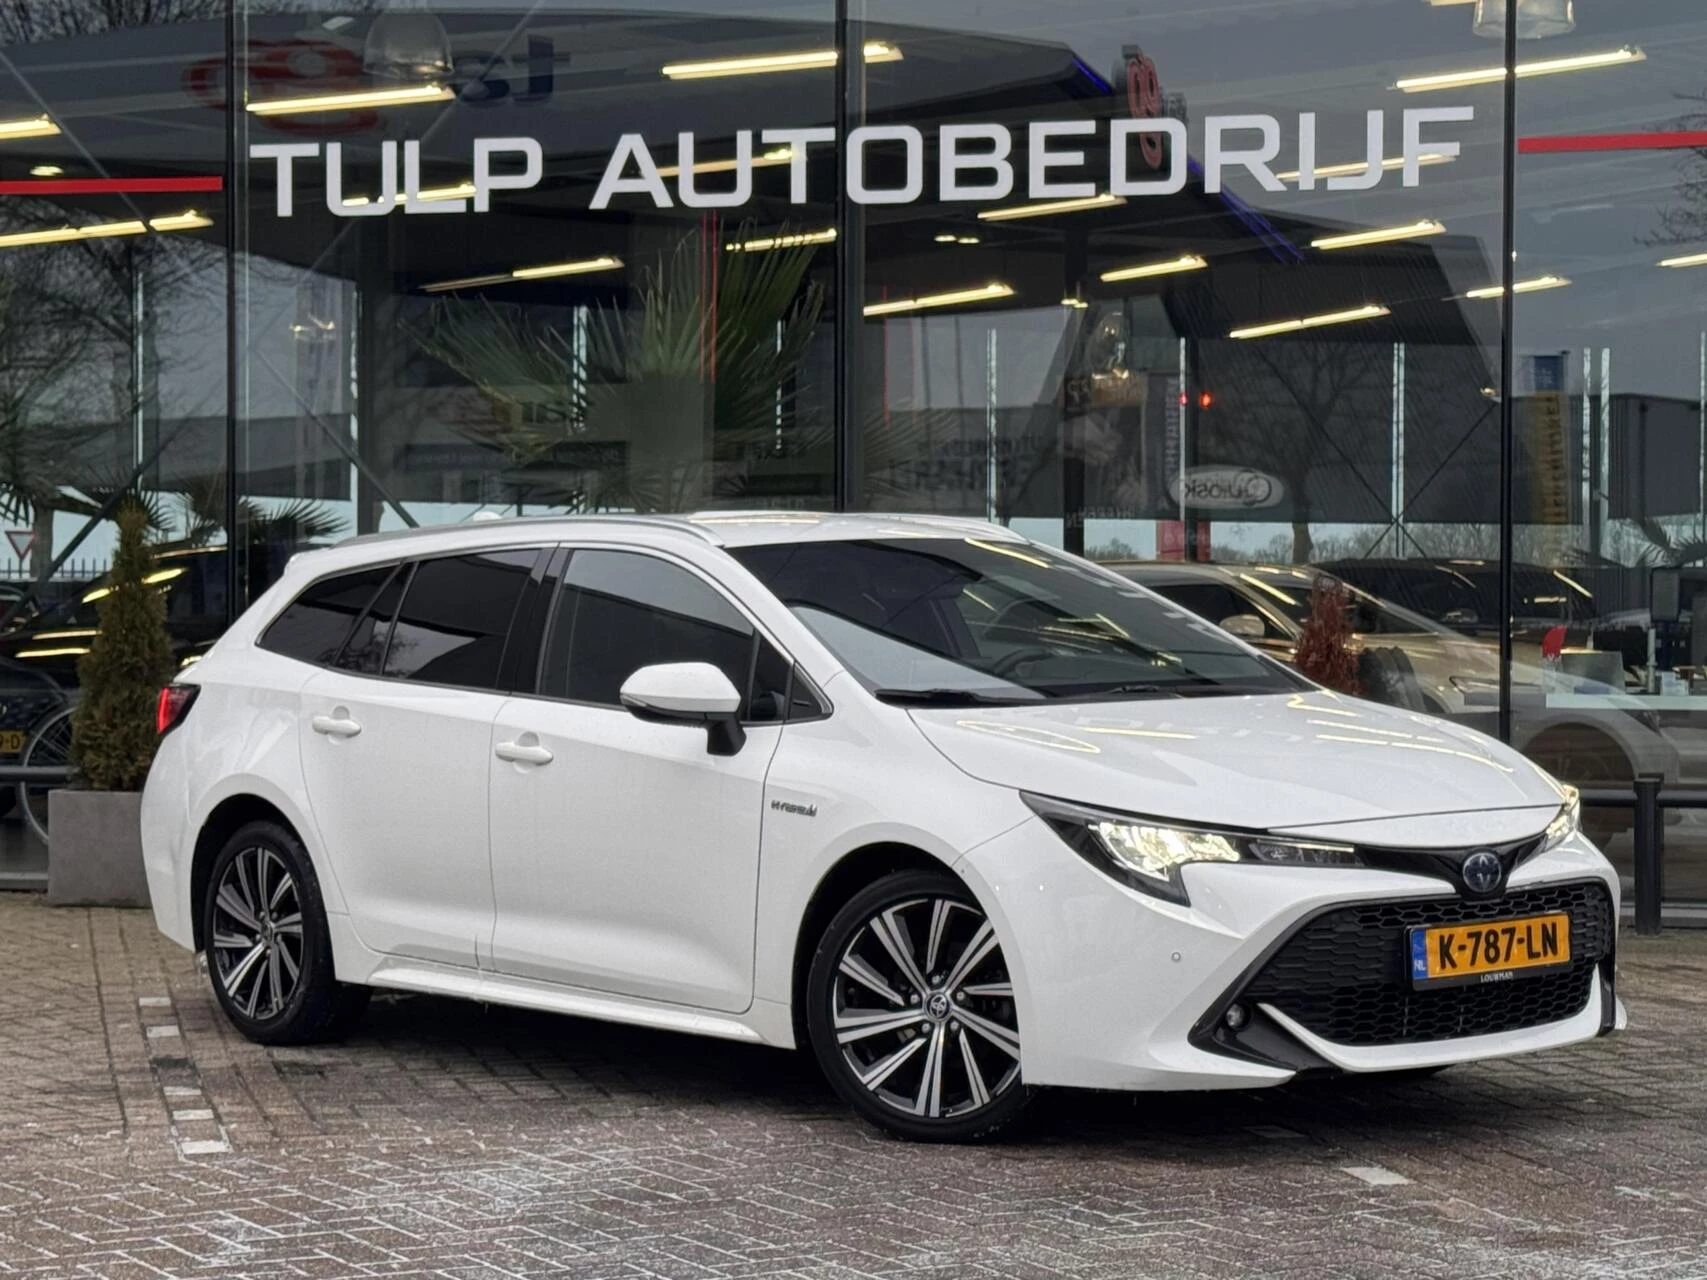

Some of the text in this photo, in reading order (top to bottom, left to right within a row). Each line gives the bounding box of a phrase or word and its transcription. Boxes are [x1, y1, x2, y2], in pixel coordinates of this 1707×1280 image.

[249, 106, 1474, 217] TULP AUTOBEDRIJF
[1414, 959, 1426, 971] NL
[1438, 922, 1558, 970] K-787-LN
